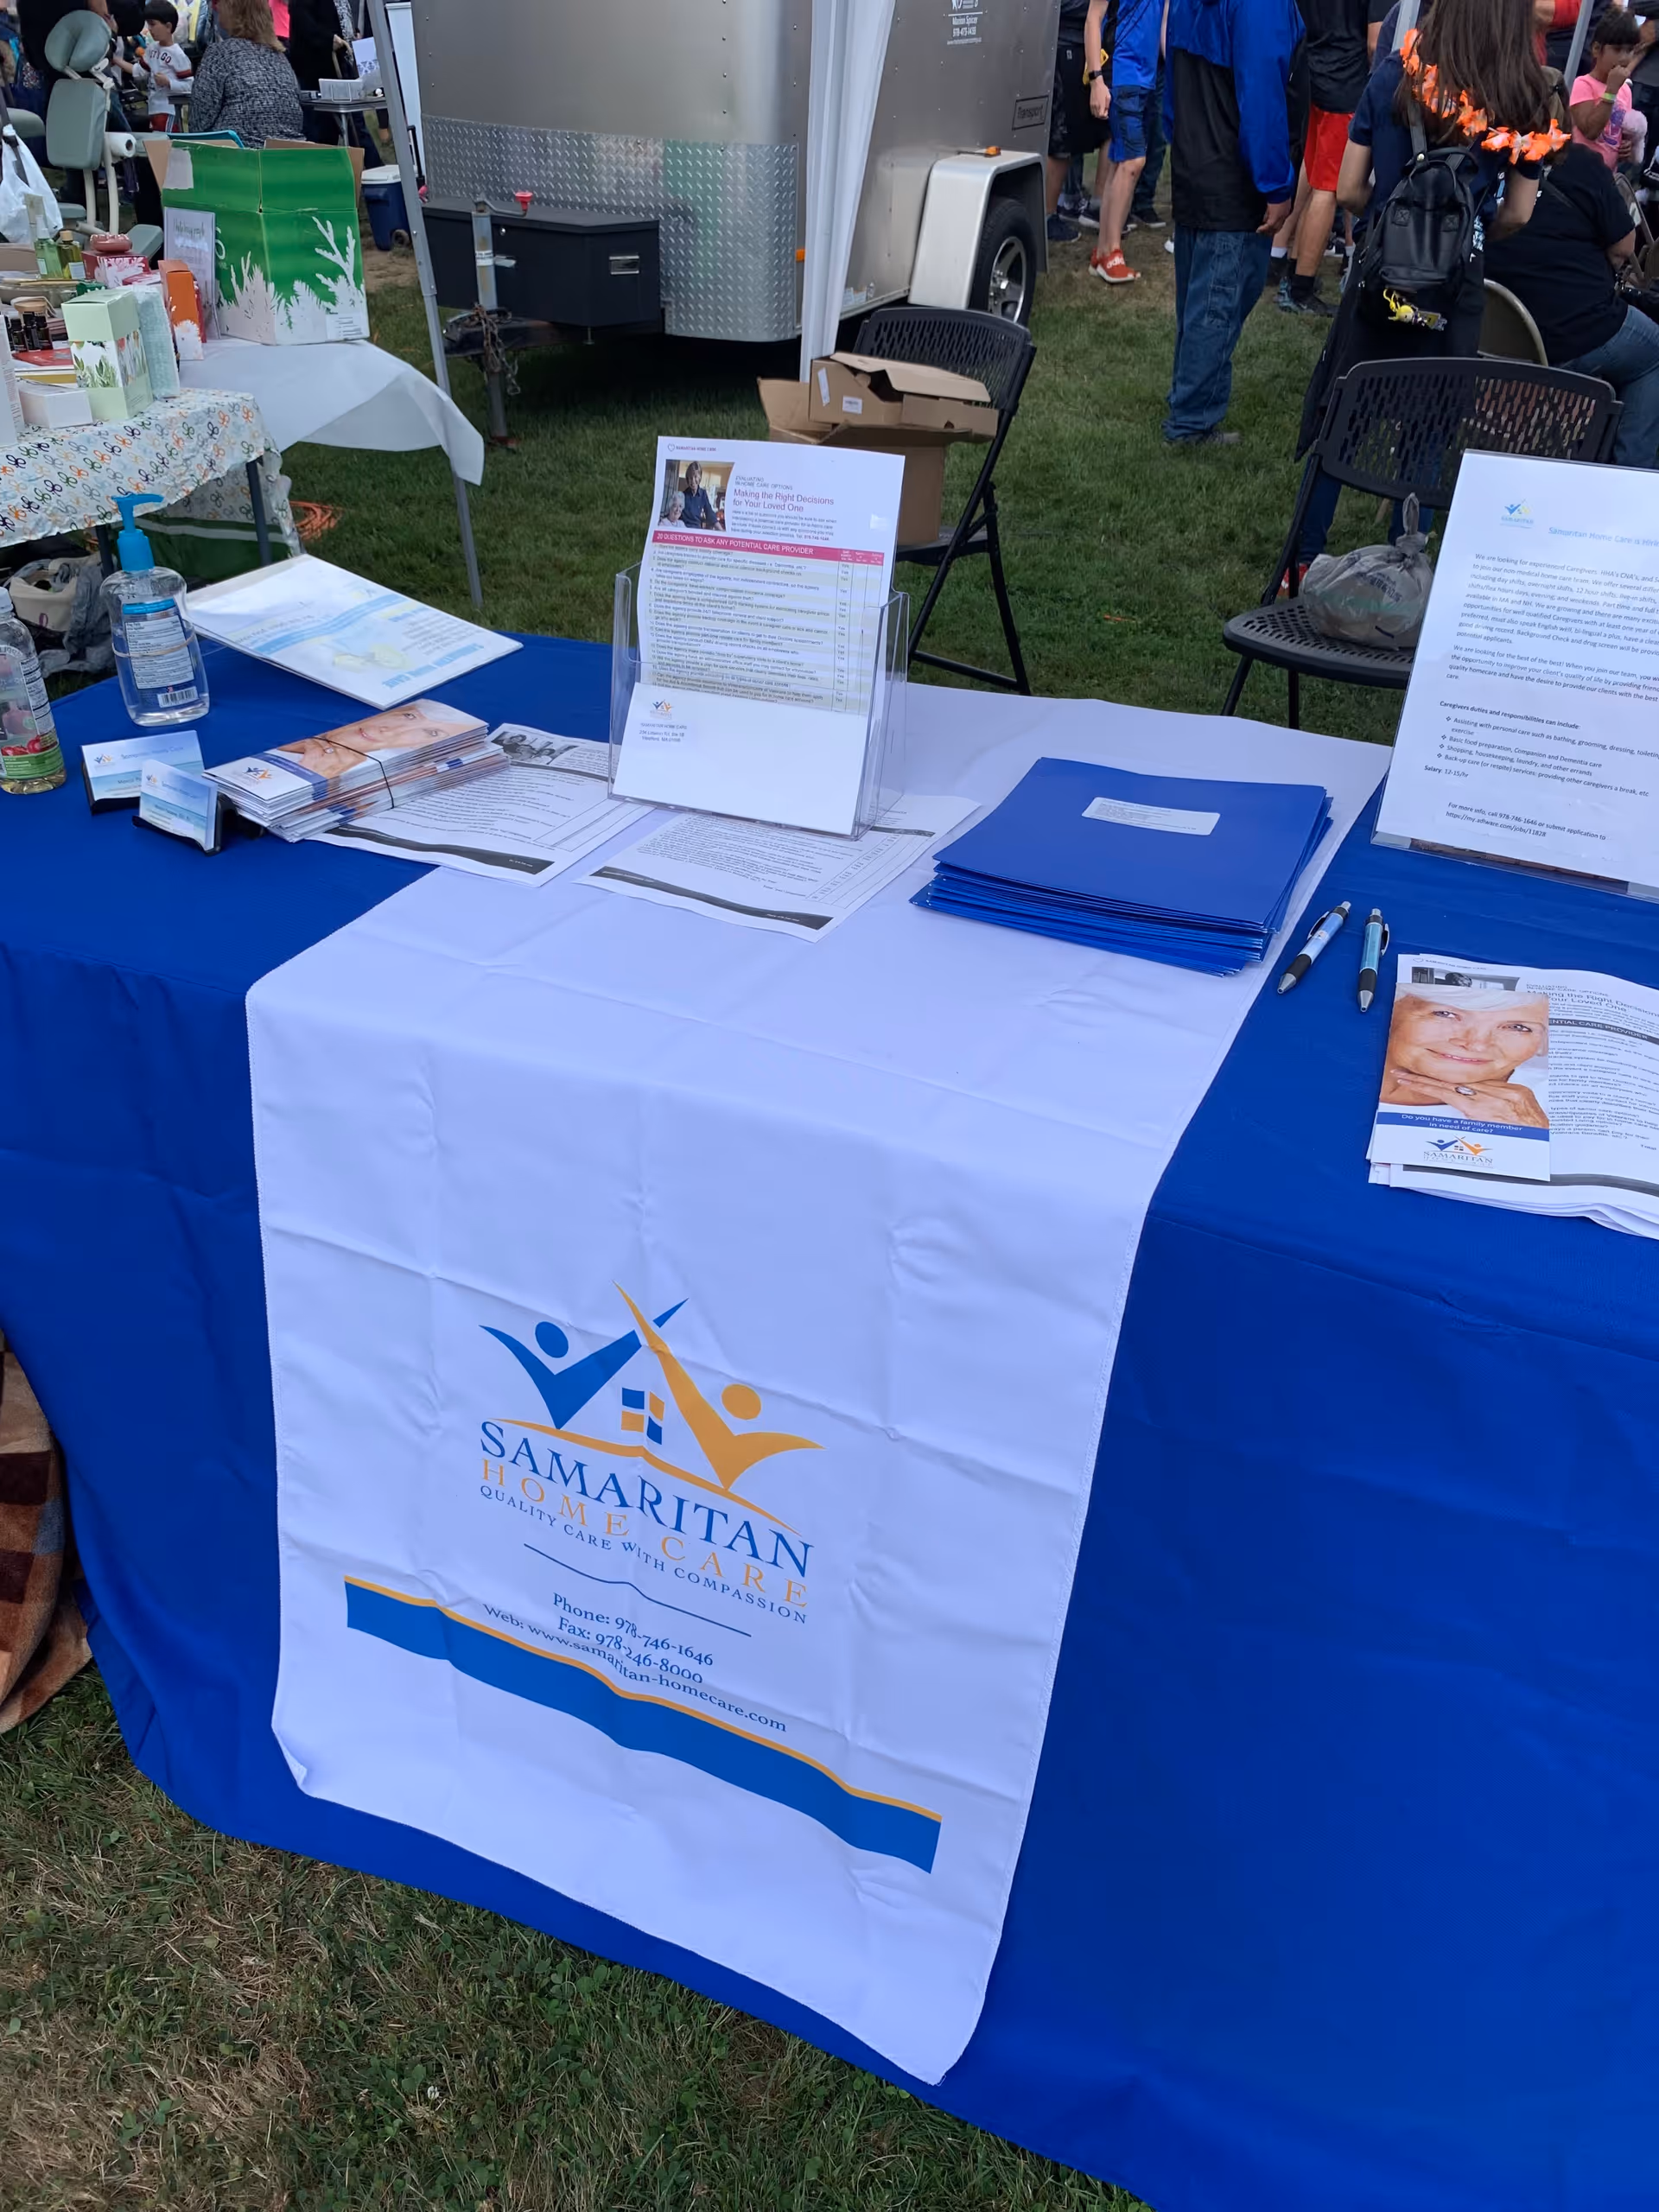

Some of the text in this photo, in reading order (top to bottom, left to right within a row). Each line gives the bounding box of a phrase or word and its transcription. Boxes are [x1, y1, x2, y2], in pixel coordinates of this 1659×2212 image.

[734, 489, 834, 505] Making the Right Decisions
[743, 499, 760, 508] Your
[763, 501, 785, 510] Loved
[787, 503, 804, 512] One
[663, 533, 694, 543] QUESTIONS
[729, 539, 762, 550] POTENTIAL
[763, 543, 780, 551] CARE
[781, 544, 813, 555] PROVIDER
[1461, 656, 1495, 667] opportunity
[1503, 662, 1527, 673] improve
[1611, 680, 1642, 690] providing
[1468, 666, 1497, 676] homecare
[1535, 677, 1554, 685] desire
[1561, 682, 1586, 690] provide
[1440, 700, 1469, 710] Caregivers
[1500, 711, 1544, 723] responsibilities
[1556, 720, 1580, 729] include:
[1452, 717, 1478, 728] Assisting
[1553, 734, 1576, 745] bathing,
[1577, 740, 1607, 750] grooming,
[1608, 744, 1635, 754] dressing,
[1446, 745, 1473, 755] Shopping,
[1474, 750, 1515, 763] housekeeping,
[1516, 757, 1540, 767] laundry,
[1478, 741, 1512, 753] preparation,
[1513, 747, 1546, 758] Companion
[1559, 755, 1588, 765] Dementia
[1444, 753, 1466, 764] Back-up
[1490, 763, 1512, 772] respite)
[1537, 772, 1565, 782] providing
[1582, 780, 1613, 790] caregivers
[1618, 785, 1637, 795] break,
[1498, 812, 1537, 825] 978-746-1646
[1566, 828, 1599, 838] application
[1571, 997, 1602, 1007] Loved
[1605, 1002, 1626, 1012] One
[1586, 995, 1614, 1006] Right
[1604, 1025, 1648, 1040] PROVIDER
[1423, 1151, 1492, 1164] SAMARITAN
[480, 1421, 814, 1578] SAMARITAN
[482, 1458, 808, 1608] HOME CARE
[480, 1485, 808, 1624] QUALITY CARE WITH COMPASSION
[553, 1592, 713, 1666] Phone: 978-746-1646
[557, 1616, 703, 1684] Fax: 978-246-8000
[483, 1604, 786, 1732] Web: www.samaritan-homecare.com
